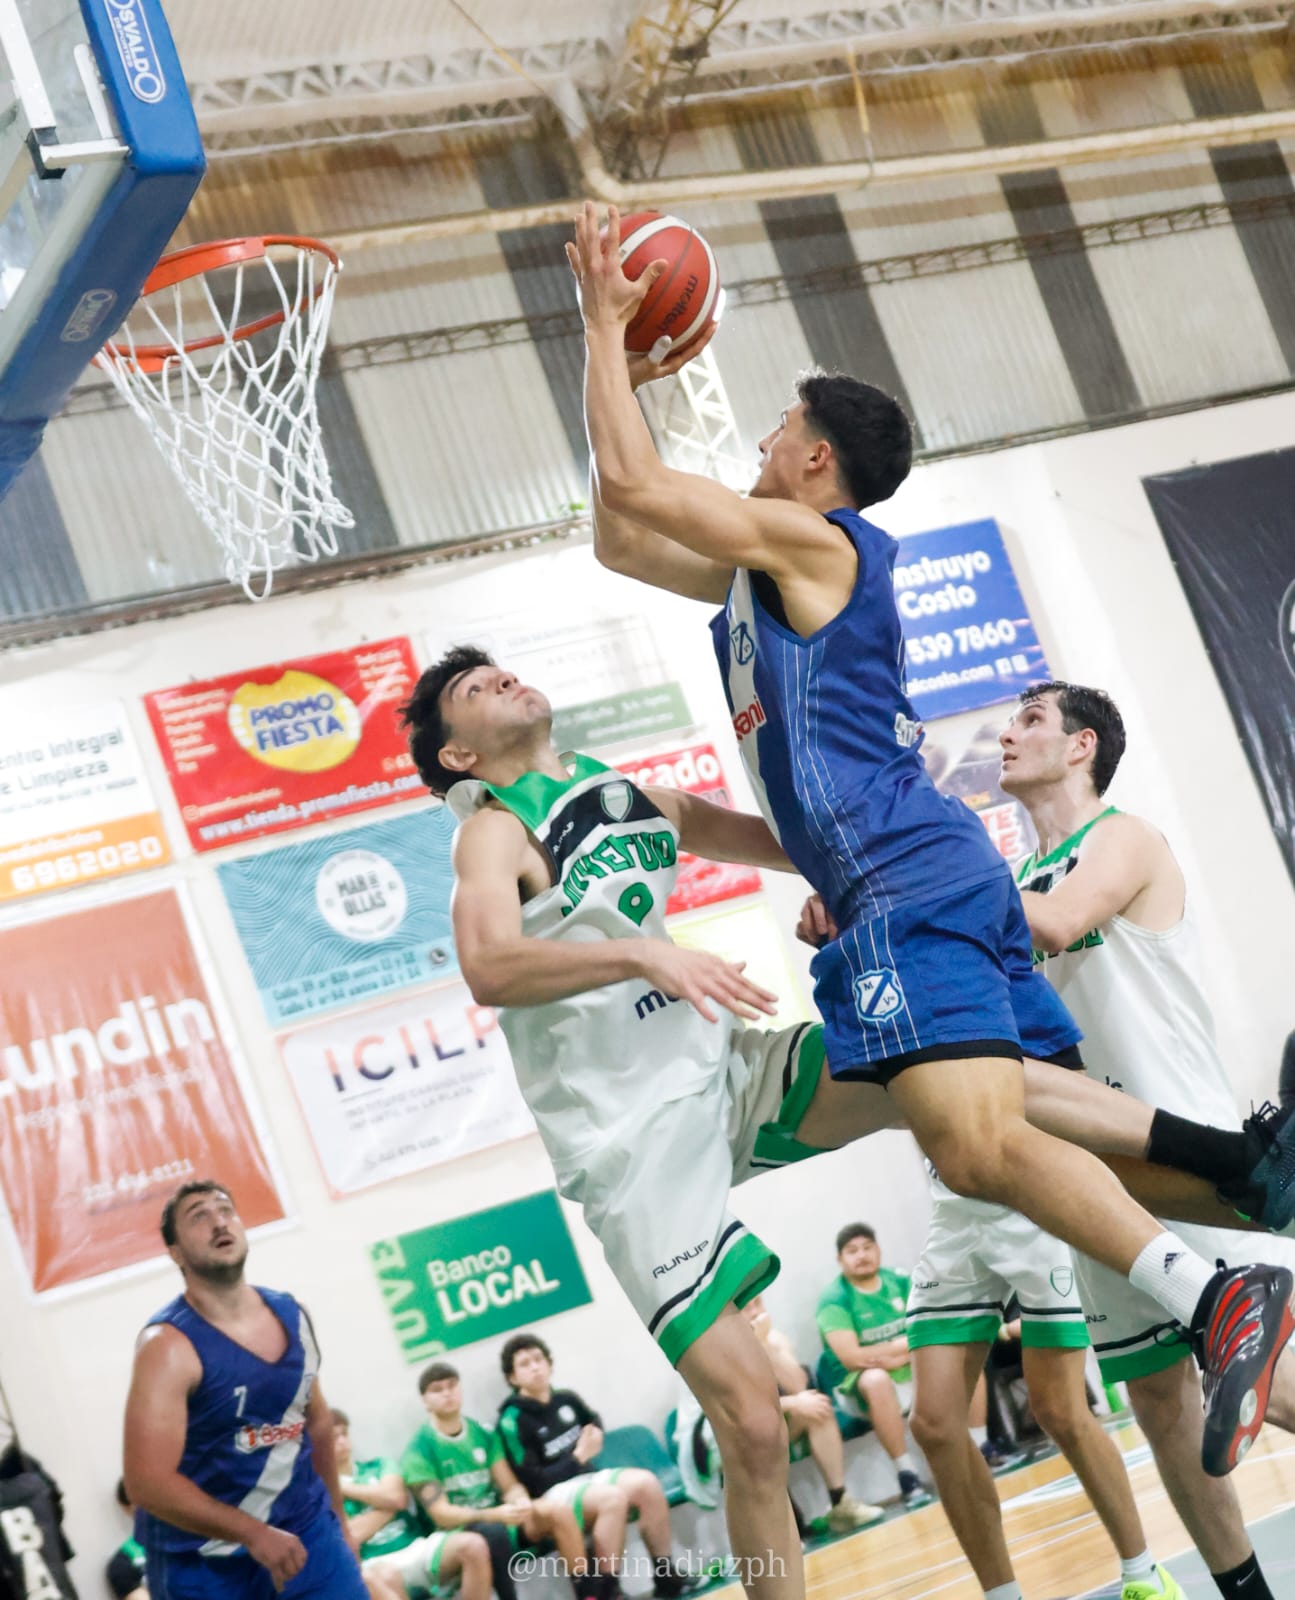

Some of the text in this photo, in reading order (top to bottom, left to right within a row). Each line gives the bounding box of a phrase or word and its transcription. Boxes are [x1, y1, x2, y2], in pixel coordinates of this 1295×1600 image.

[656, 274, 699, 332] molten
[898, 582, 977, 619] Costo
[953, 618, 1016, 654] 7860
[249, 692, 335, 727] PROMO
[49, 726, 125, 759] Integral
[256, 715, 344, 752] FIESTA
[18, 760, 110, 791] Limpieza
[324, 1004, 499, 1093] ICILP
[427, 1245, 512, 1287] Banco
[652, 1239, 709, 1279] RUNUP
[436, 1258, 561, 1324] LOCAL
[234, 1385, 247, 1418] 7
